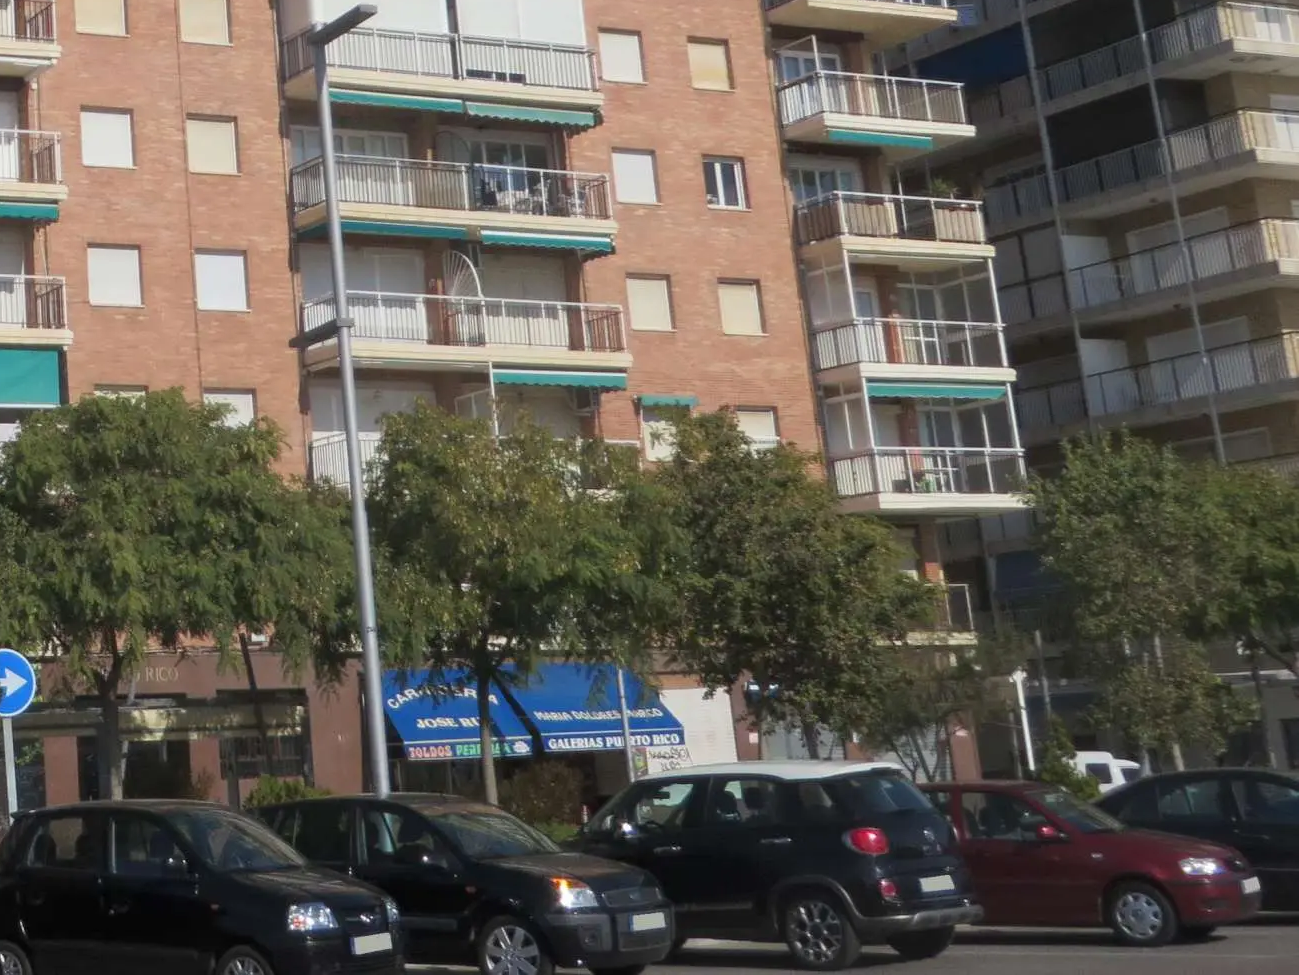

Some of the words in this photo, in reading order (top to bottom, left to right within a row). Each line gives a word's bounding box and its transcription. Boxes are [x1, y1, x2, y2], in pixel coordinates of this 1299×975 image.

[145, 666, 179, 683] RICO
[548, 736, 604, 749] GALERIAS
[605, 734, 651, 748] PURTO
[653, 732, 680, 745] RICO
